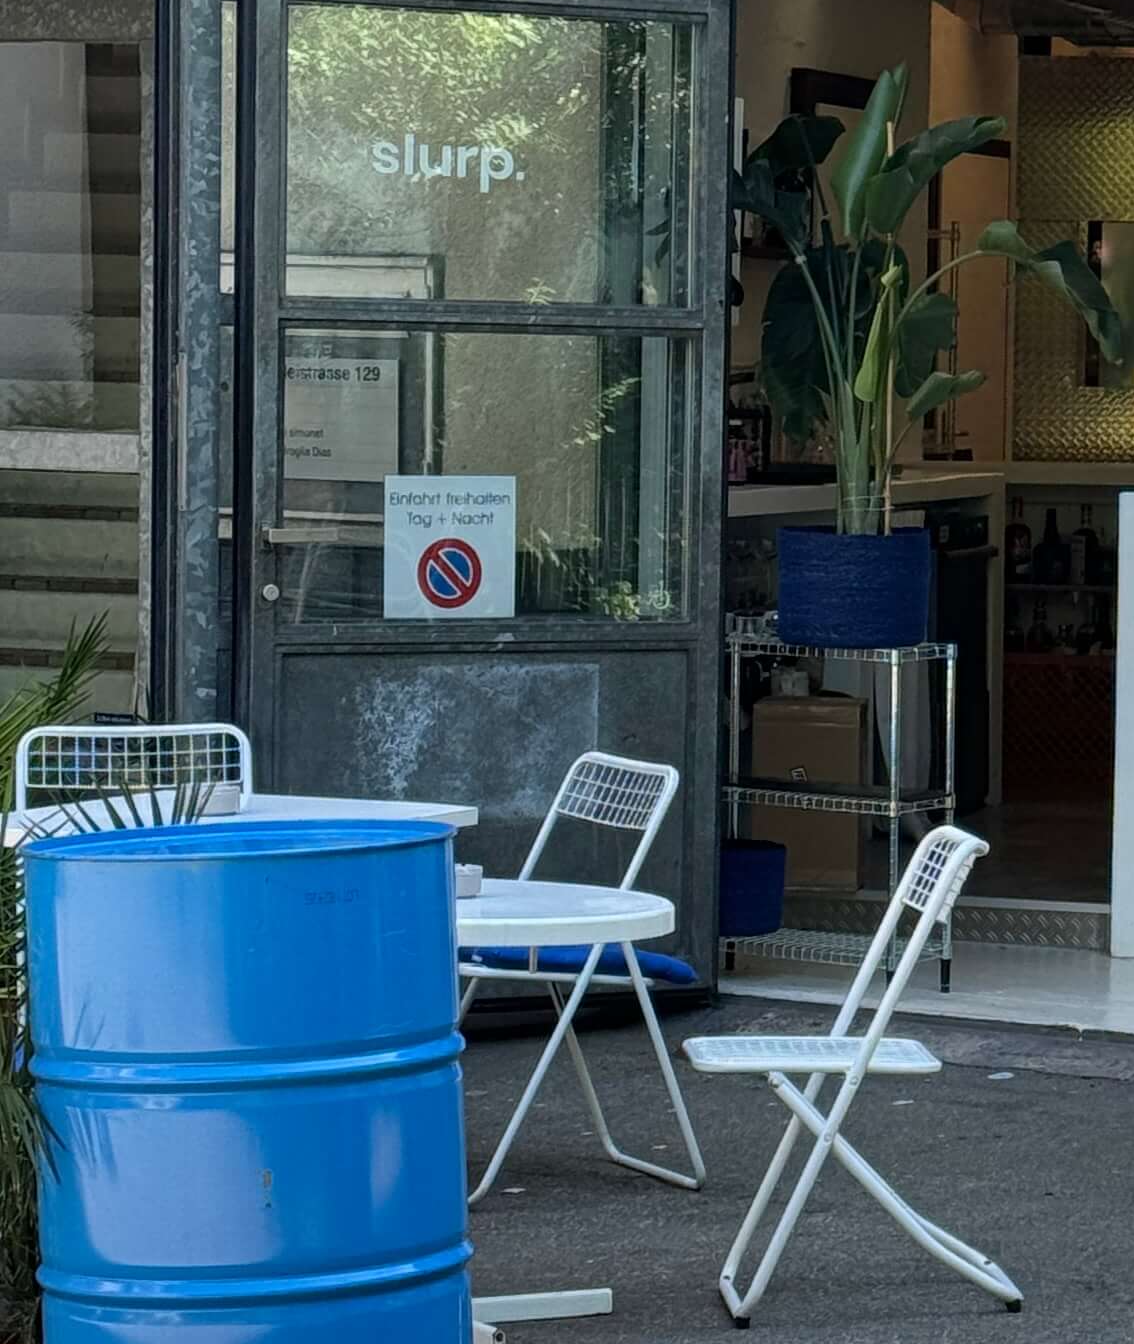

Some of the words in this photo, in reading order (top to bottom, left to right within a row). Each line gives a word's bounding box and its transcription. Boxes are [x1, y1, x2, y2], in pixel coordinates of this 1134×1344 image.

[372, 133, 524, 193] slurp.
[355, 366, 381, 382] 129
[389, 491, 441, 506] Einfahrt
[446, 491, 512, 506] freihalten
[407, 511, 433, 529] Tag
[451, 511, 495, 526] Nacht
